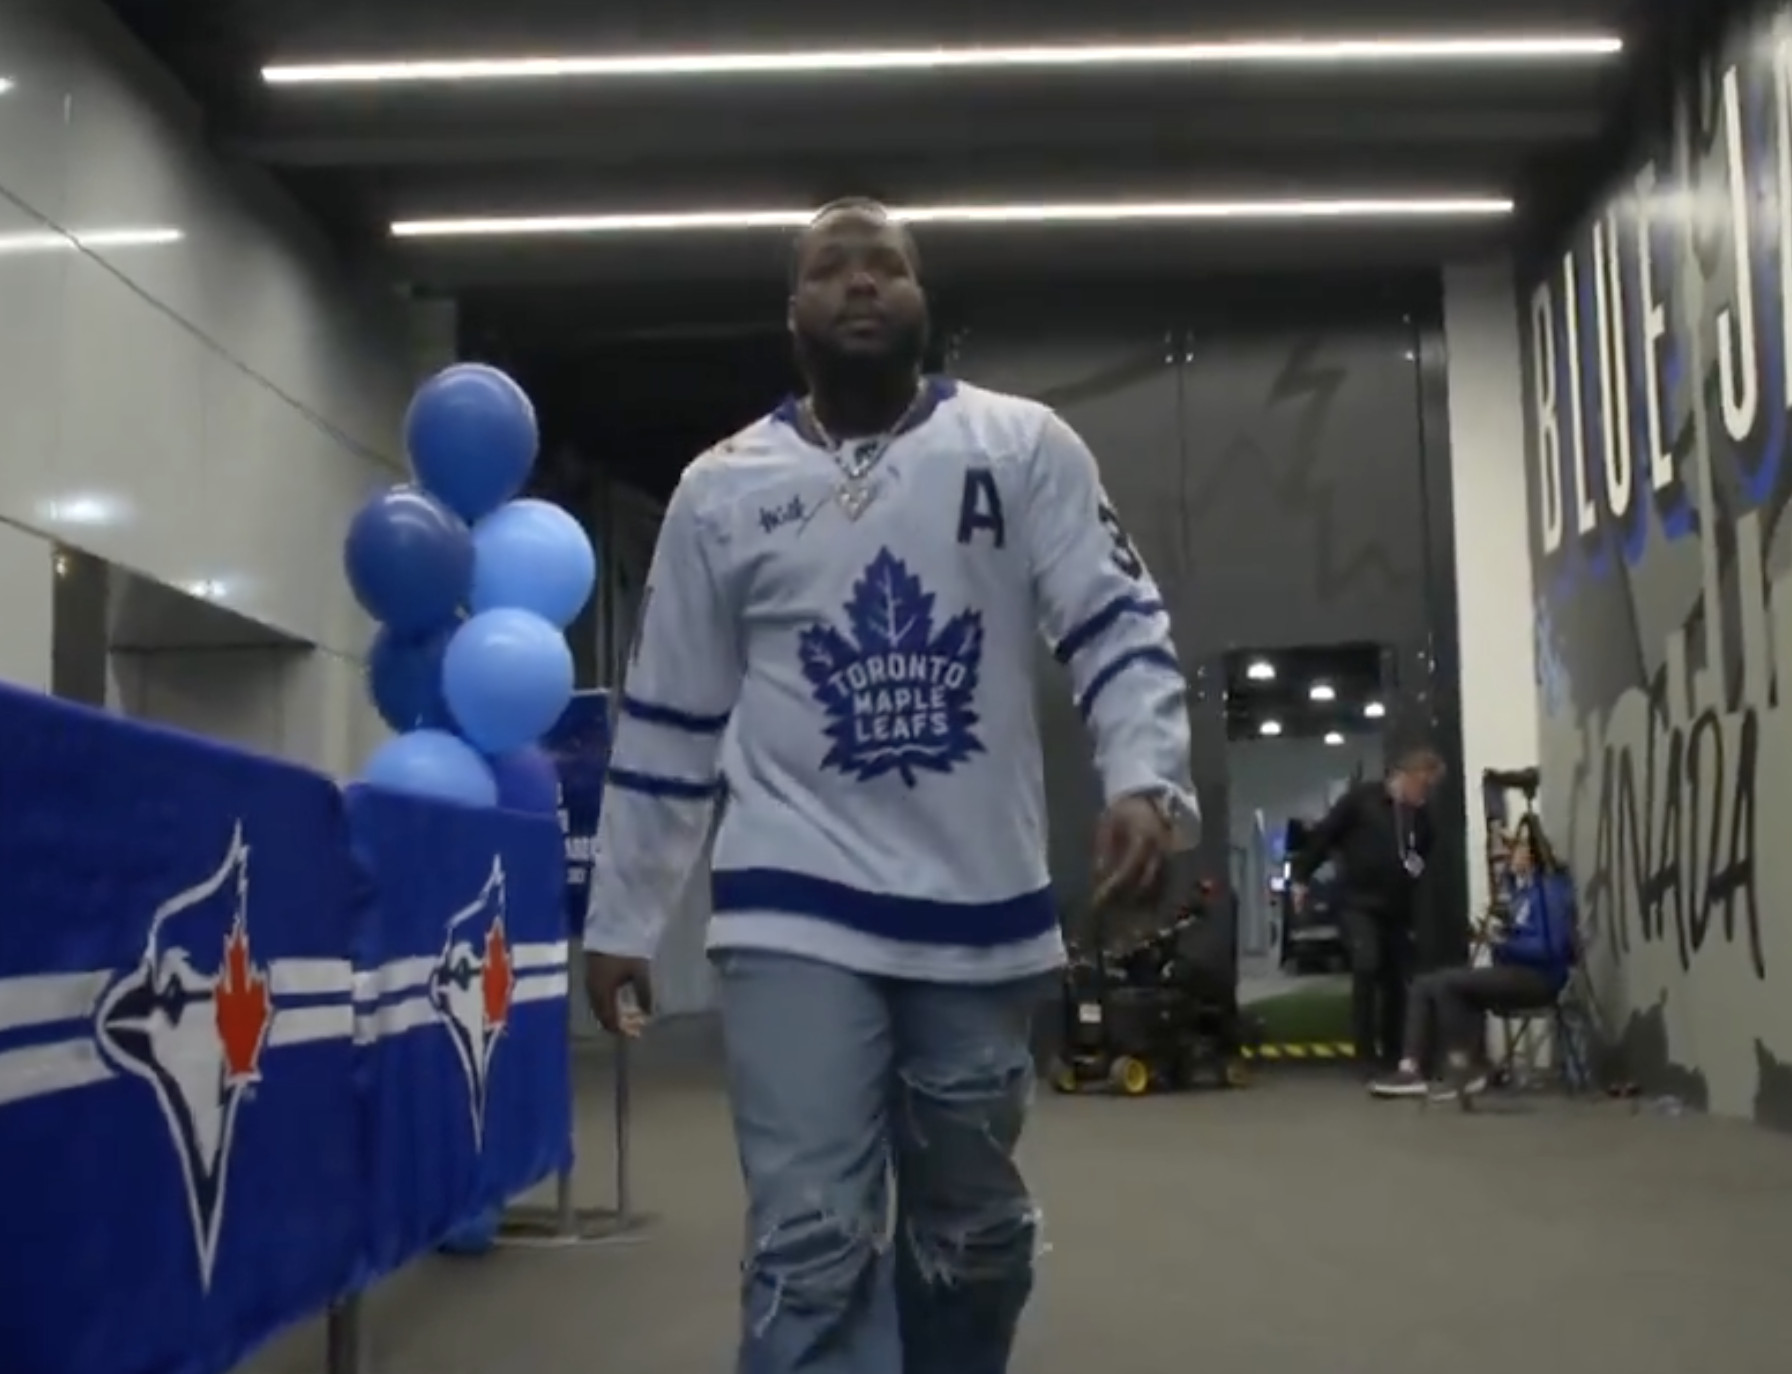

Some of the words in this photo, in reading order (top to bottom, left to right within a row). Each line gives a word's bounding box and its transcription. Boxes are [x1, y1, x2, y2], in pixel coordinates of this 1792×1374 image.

[1531, 160, 1674, 556] BLUE
[957, 467, 1006, 550] A
[827, 652, 967, 698] TORONTO
[853, 684, 947, 715] MAPLE
[855, 711, 949, 744] LEAFS
[1567, 700, 1766, 981] CANADA
